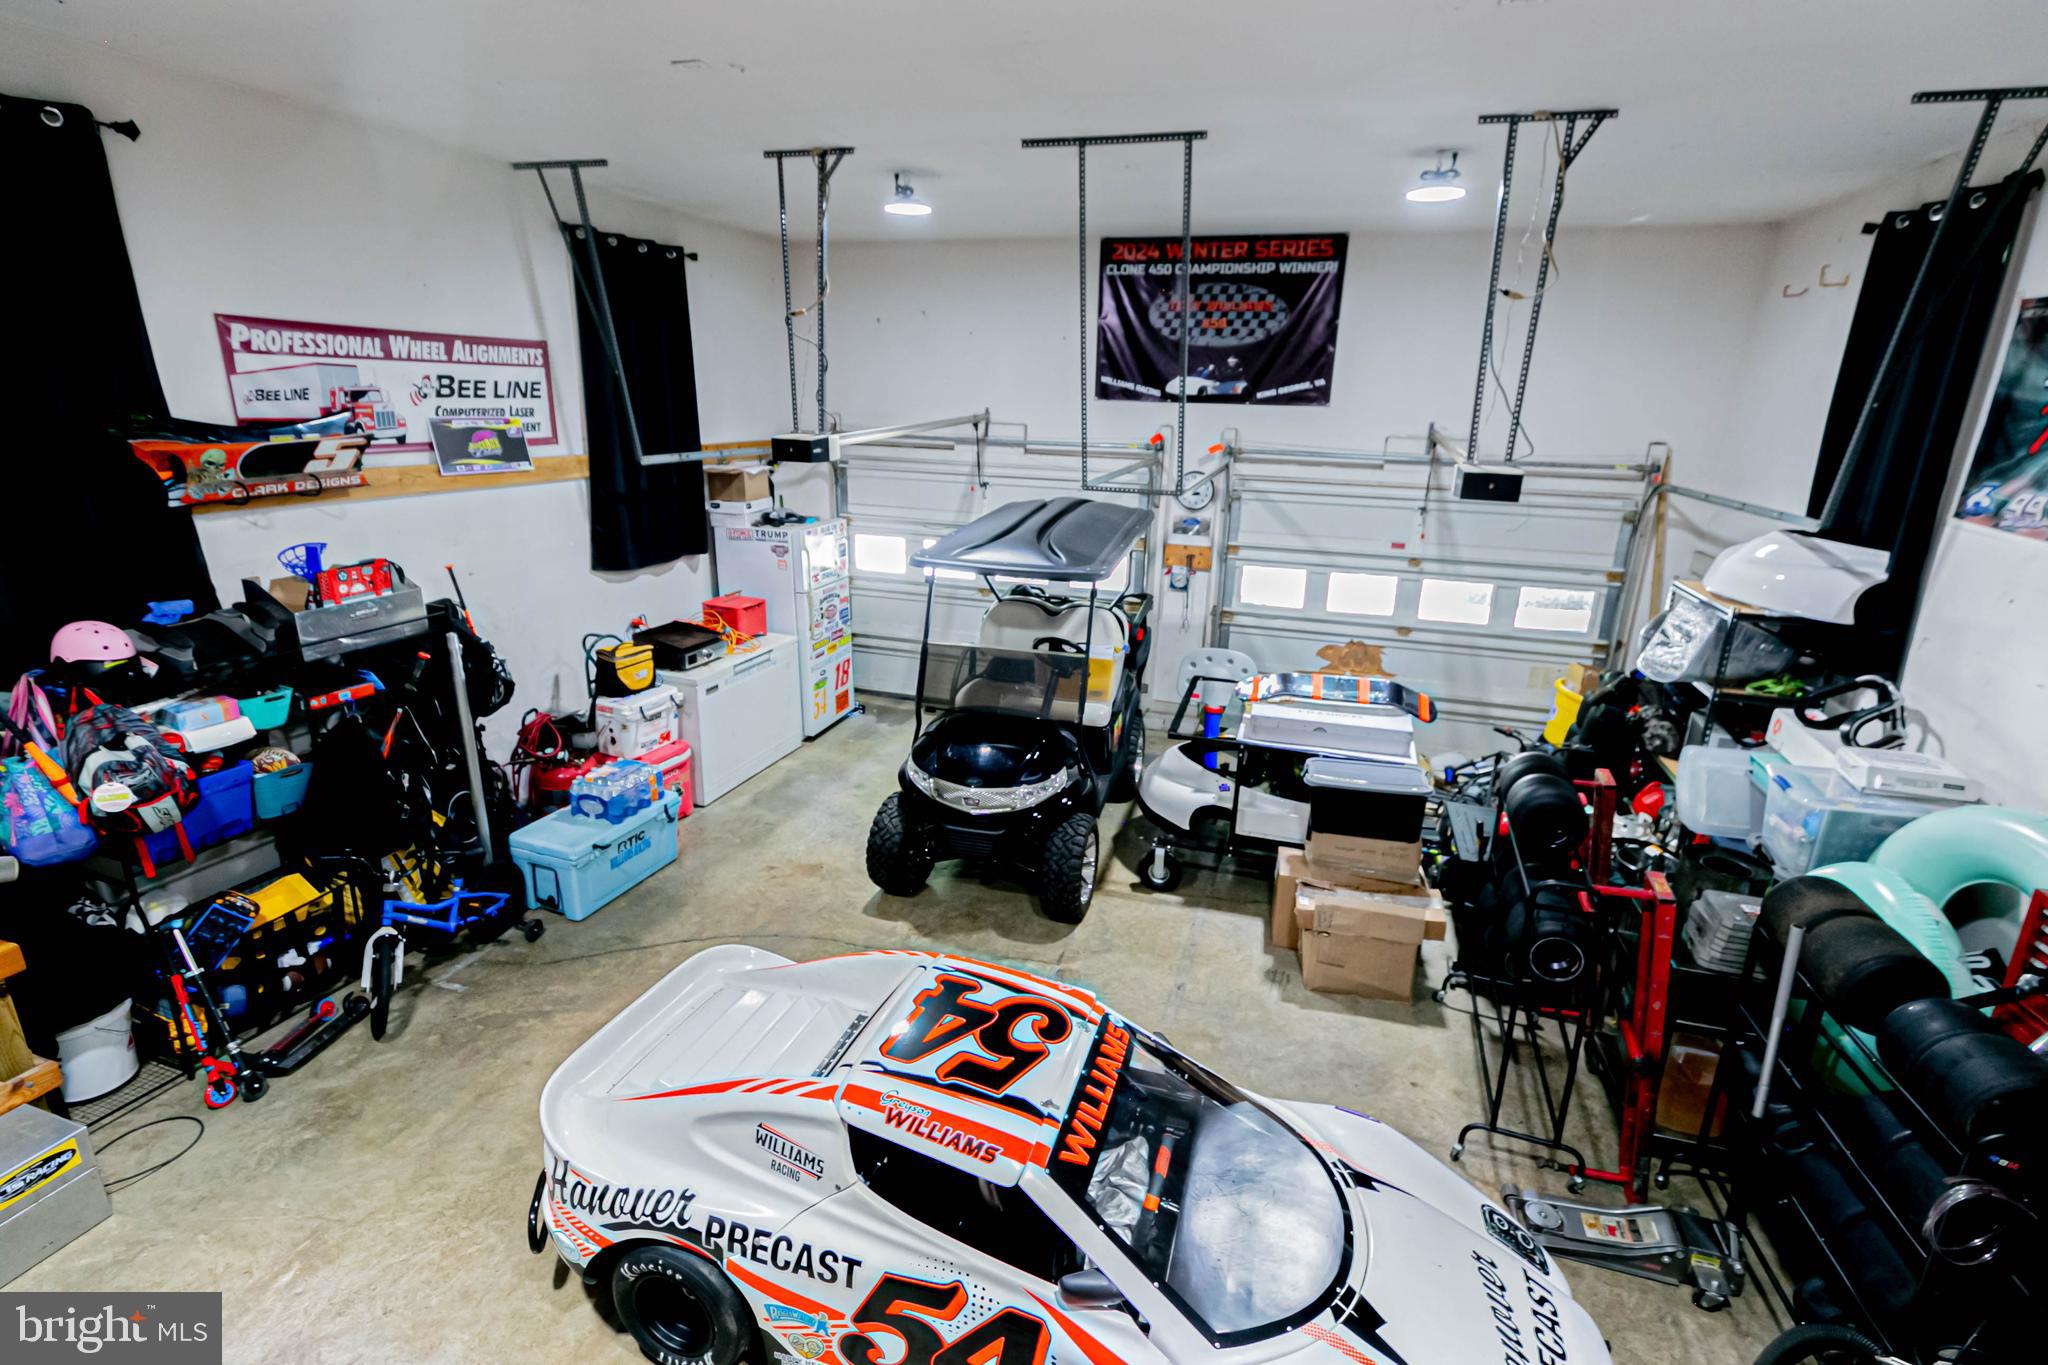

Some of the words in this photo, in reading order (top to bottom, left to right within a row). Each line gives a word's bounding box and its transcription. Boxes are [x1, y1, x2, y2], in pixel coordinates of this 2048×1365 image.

[1111, 242, 1160, 261] 2024
[1166, 240, 1248, 260] WNTER
[1254, 239, 1335, 258] SERIES
[1106, 263, 1146, 275] CLONE
[1148, 263, 1172, 275] 450
[1174, 261, 1276, 275] CAMPIONSHIP
[229, 322, 384, 358] PROFESSIONAL
[389, 334, 447, 362] WHEEL
[452, 338, 544, 366] ALIGNMENTS
[255, 388, 281, 401] BEE
[284, 387, 310, 401] LINE
[435, 374, 486, 399] BEE
[493, 381, 542, 399] LINE
[434, 405, 506, 417] COMPUTERIZED
[509, 405, 535, 418] LASER
[755, 529, 788, 539] TRUMP
[835, 656, 850, 691] 18
[617, 830, 645, 853] RTIC
[878, 972, 1073, 1096] 54
[880, 1089, 931, 1118] Greyson
[1058, 1019, 1131, 1166] WILLIAMS
[884, 1106, 1003, 1165] WILLIAMS
[755, 1128, 825, 1176] WILLIAMS
[770, 1159, 801, 1183] RACING
[550, 1156, 697, 1228] Hanover
[702, 1213, 863, 1289] PRECAST
